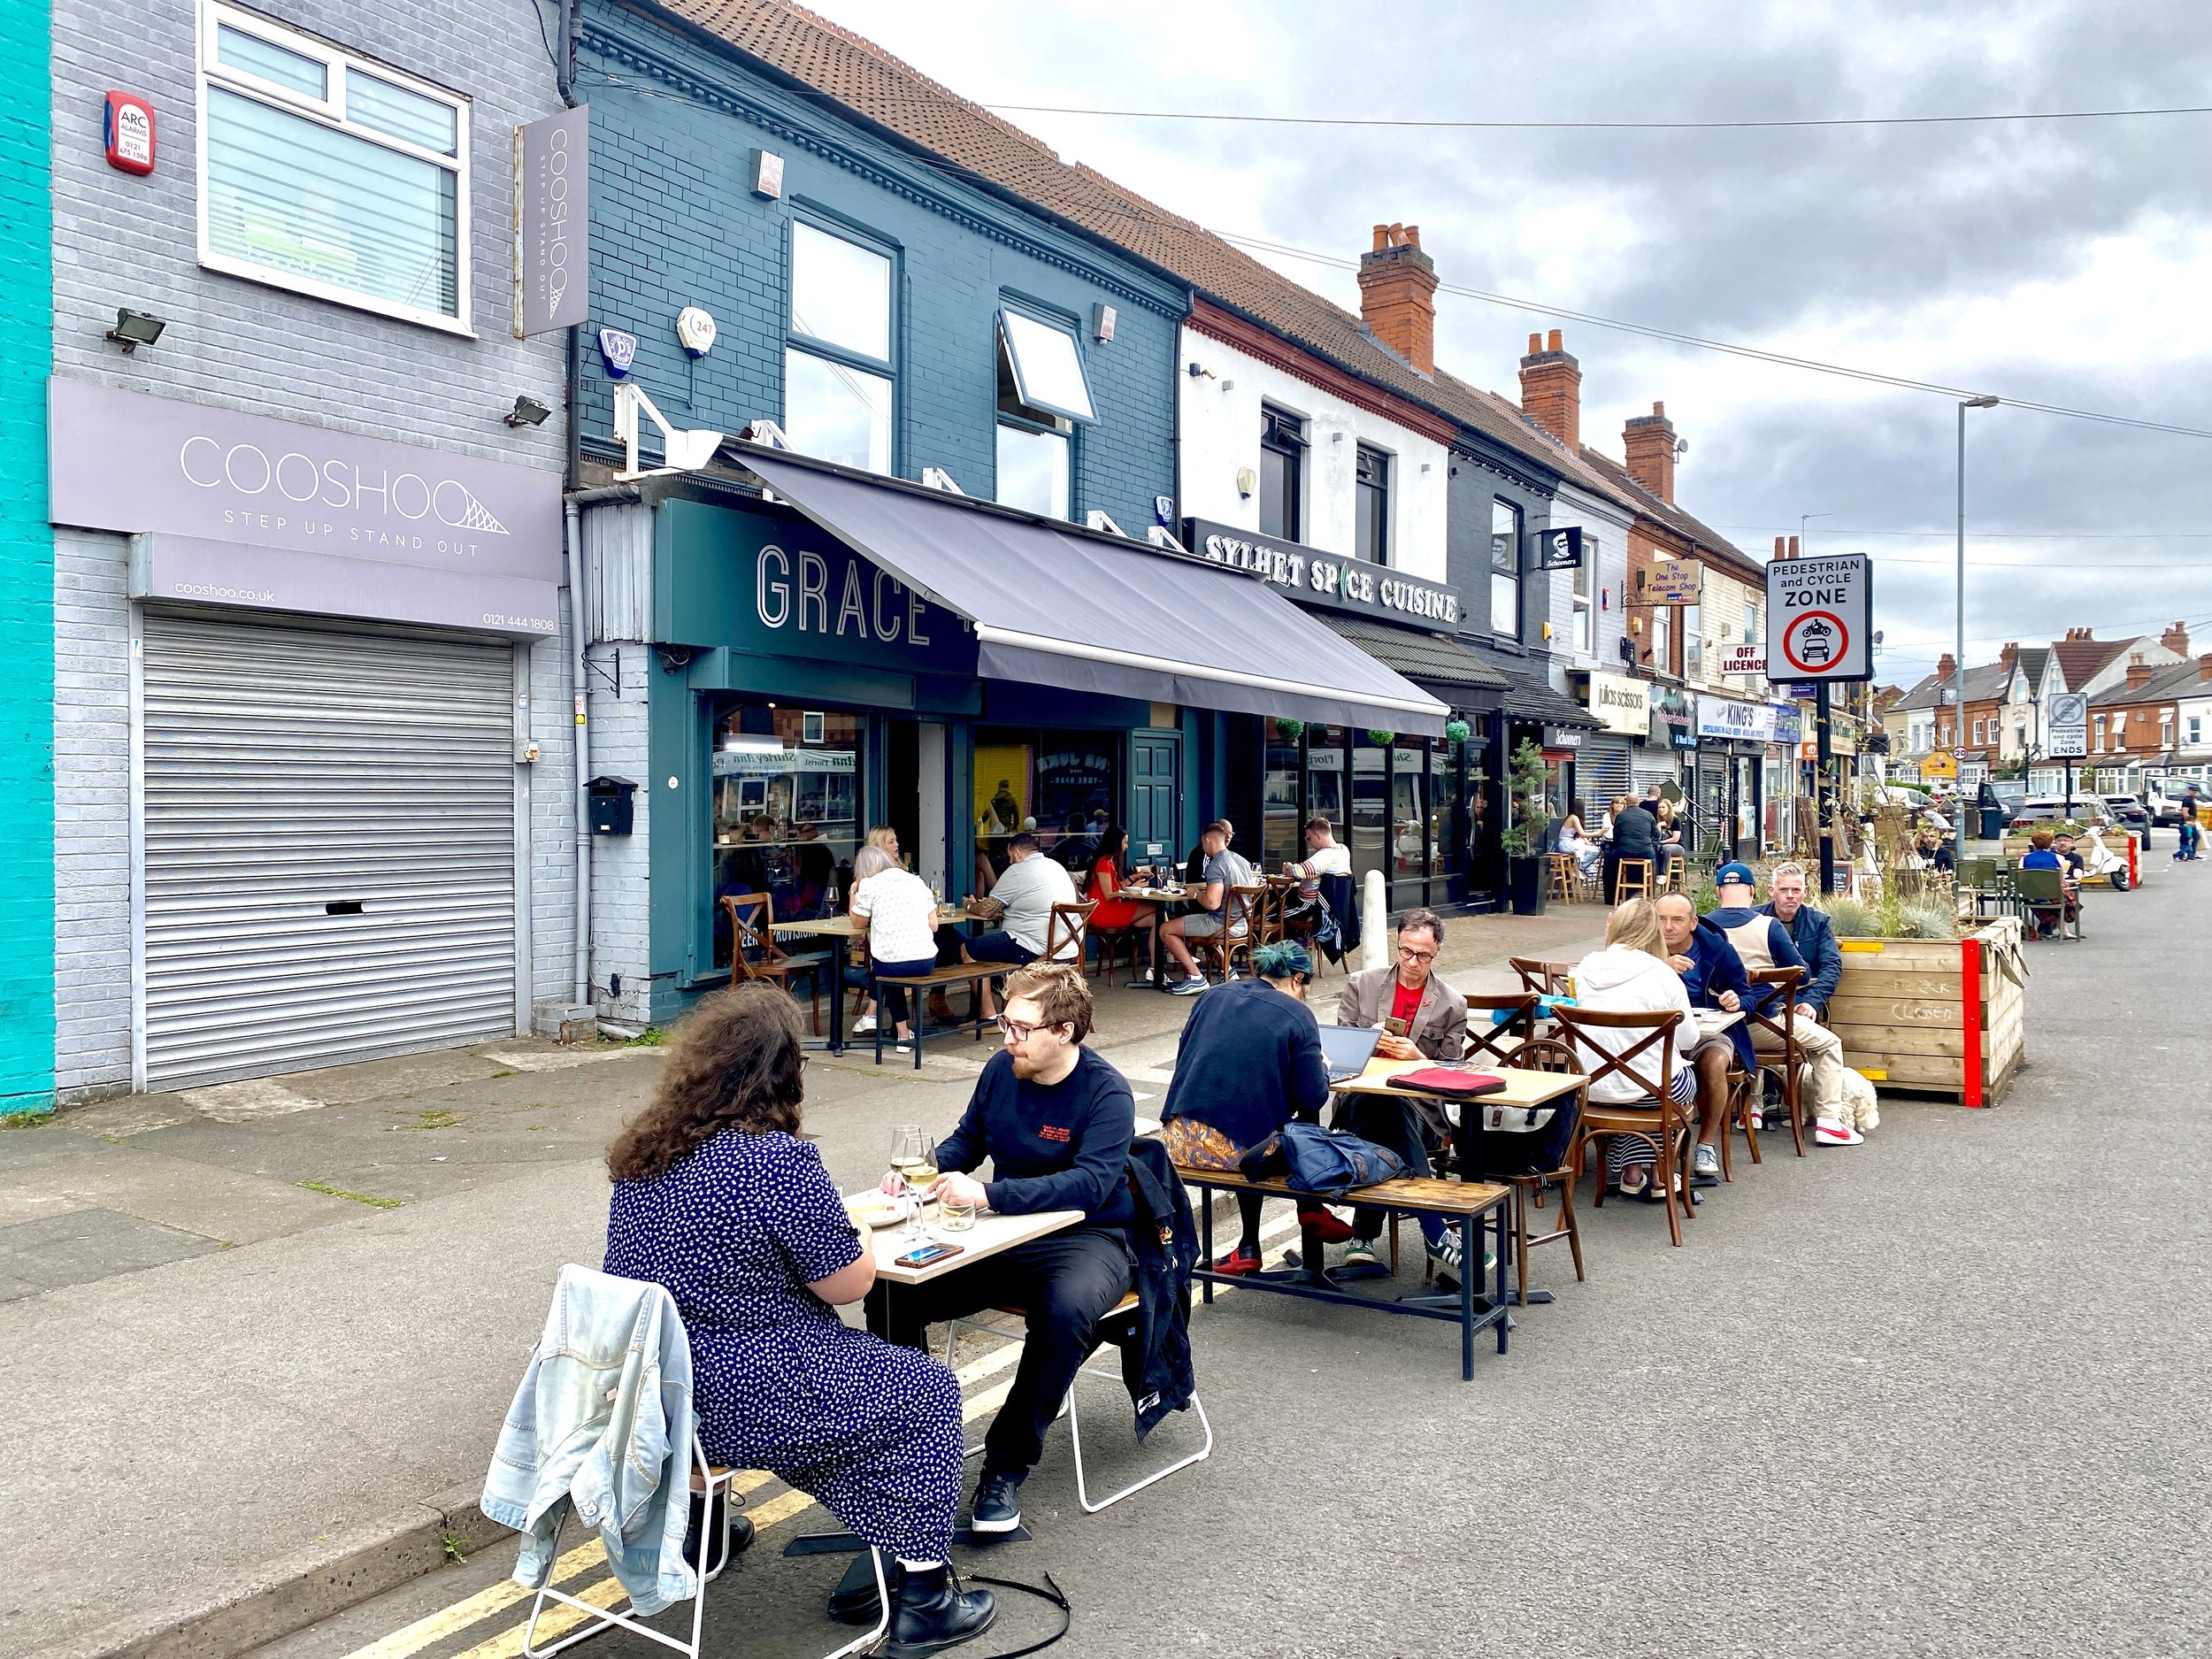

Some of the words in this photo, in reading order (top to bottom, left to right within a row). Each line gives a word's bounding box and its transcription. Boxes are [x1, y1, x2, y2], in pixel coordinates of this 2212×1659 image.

[120, 111, 147, 128] ARC
[120, 124, 148, 137] ALARMS
[119, 147, 131, 156] 475
[133, 151, 148, 161] 1596
[125, 141, 141, 150] 0121
[540, 197, 546, 213] UP
[549, 128, 568, 292] COOSHOO
[695, 321, 712, 334] 247
[180, 436, 469, 526] COOSHOO
[224, 509, 287, 530] STEP
[304, 520, 334, 536] UP
[349, 527, 423, 549] STAND
[437, 540, 479, 557] OUT
[1547, 558, 1577, 567] Schooners
[1665, 563, 1679, 572] The
[1773, 560, 1860, 576] PEDESTRIAN
[1205, 534, 1305, 588] SYLHET
[1380, 578, 1457, 624] CUISINE
[1655, 572, 1669, 581] One
[1671, 571, 1689, 581] Stop
[1780, 577, 1802, 588] and
[1807, 573, 1852, 586] CYCLE
[174, 581, 275, 603] cooshoo.co.uk
[757, 544, 930, 646] GRACE
[1647, 583, 1677, 593] Telecom
[1678, 581, 1697, 592] Shop
[1785, 588, 1847, 608] ZONE
[482, 612, 504, 626] 0121
[507, 615, 528, 627] 444
[530, 618, 554, 631] 1808
[1736, 647, 1755, 657] OFF
[1598, 683, 1617, 708] julias
[1617, 687, 1643, 710] scissors
[1656, 708, 1693, 730] Haberdashery
[1727, 703, 1754, 727] KING'S
[1555, 728, 1581, 747] Schooners
